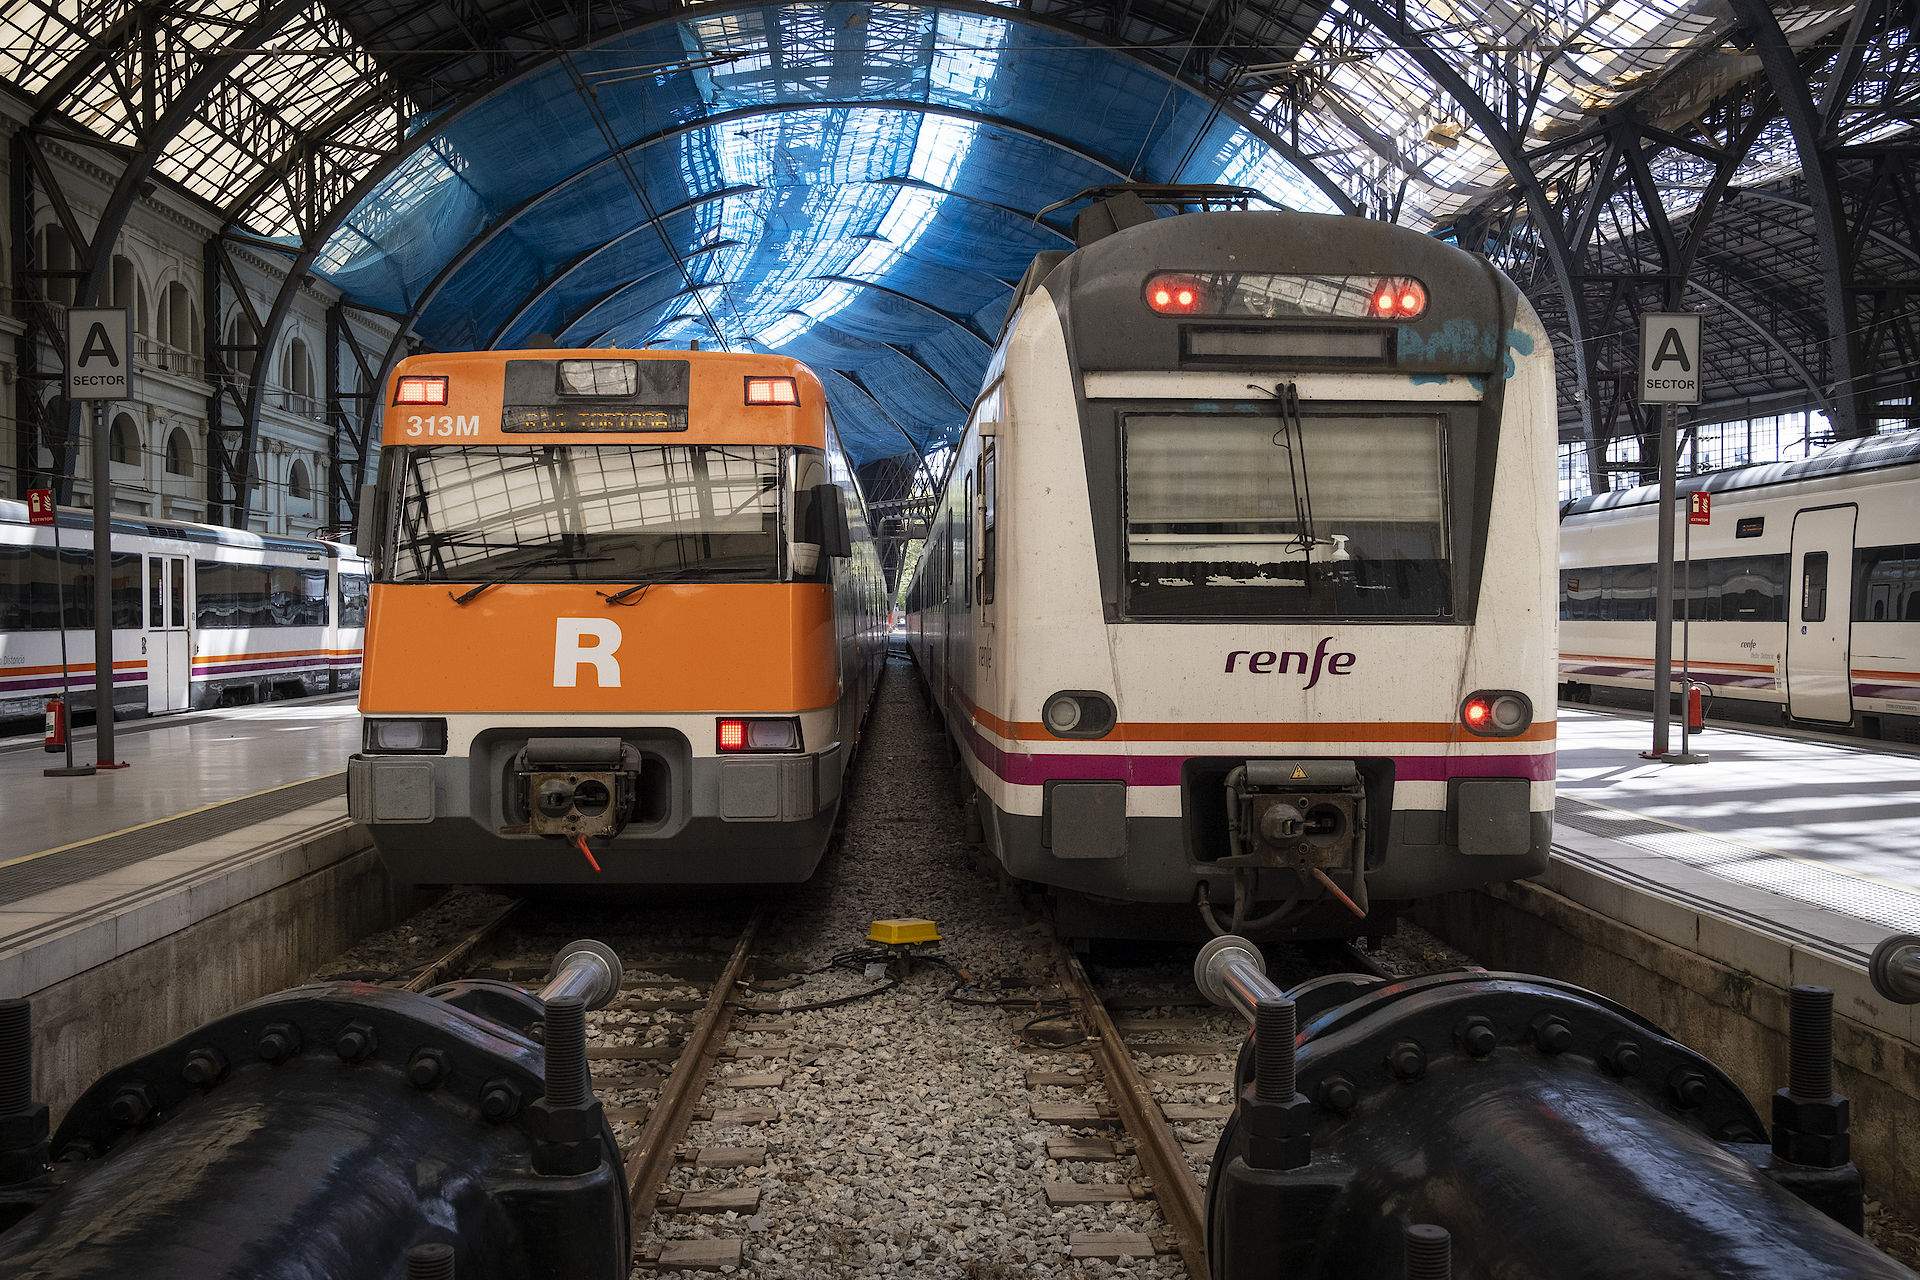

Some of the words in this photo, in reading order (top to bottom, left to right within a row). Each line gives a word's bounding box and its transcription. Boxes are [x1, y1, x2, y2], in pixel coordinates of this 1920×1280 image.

[78, 321, 119, 367] A
[1652, 327, 1690, 372] A
[73, 375, 125, 386] SECTOR
[1646, 379, 1695, 389] SECTOR
[406, 415, 480, 437] 313M
[553, 617, 622, 688] R
[1740, 639, 1757, 651] renfe
[1224, 636, 1357, 690] renfe
